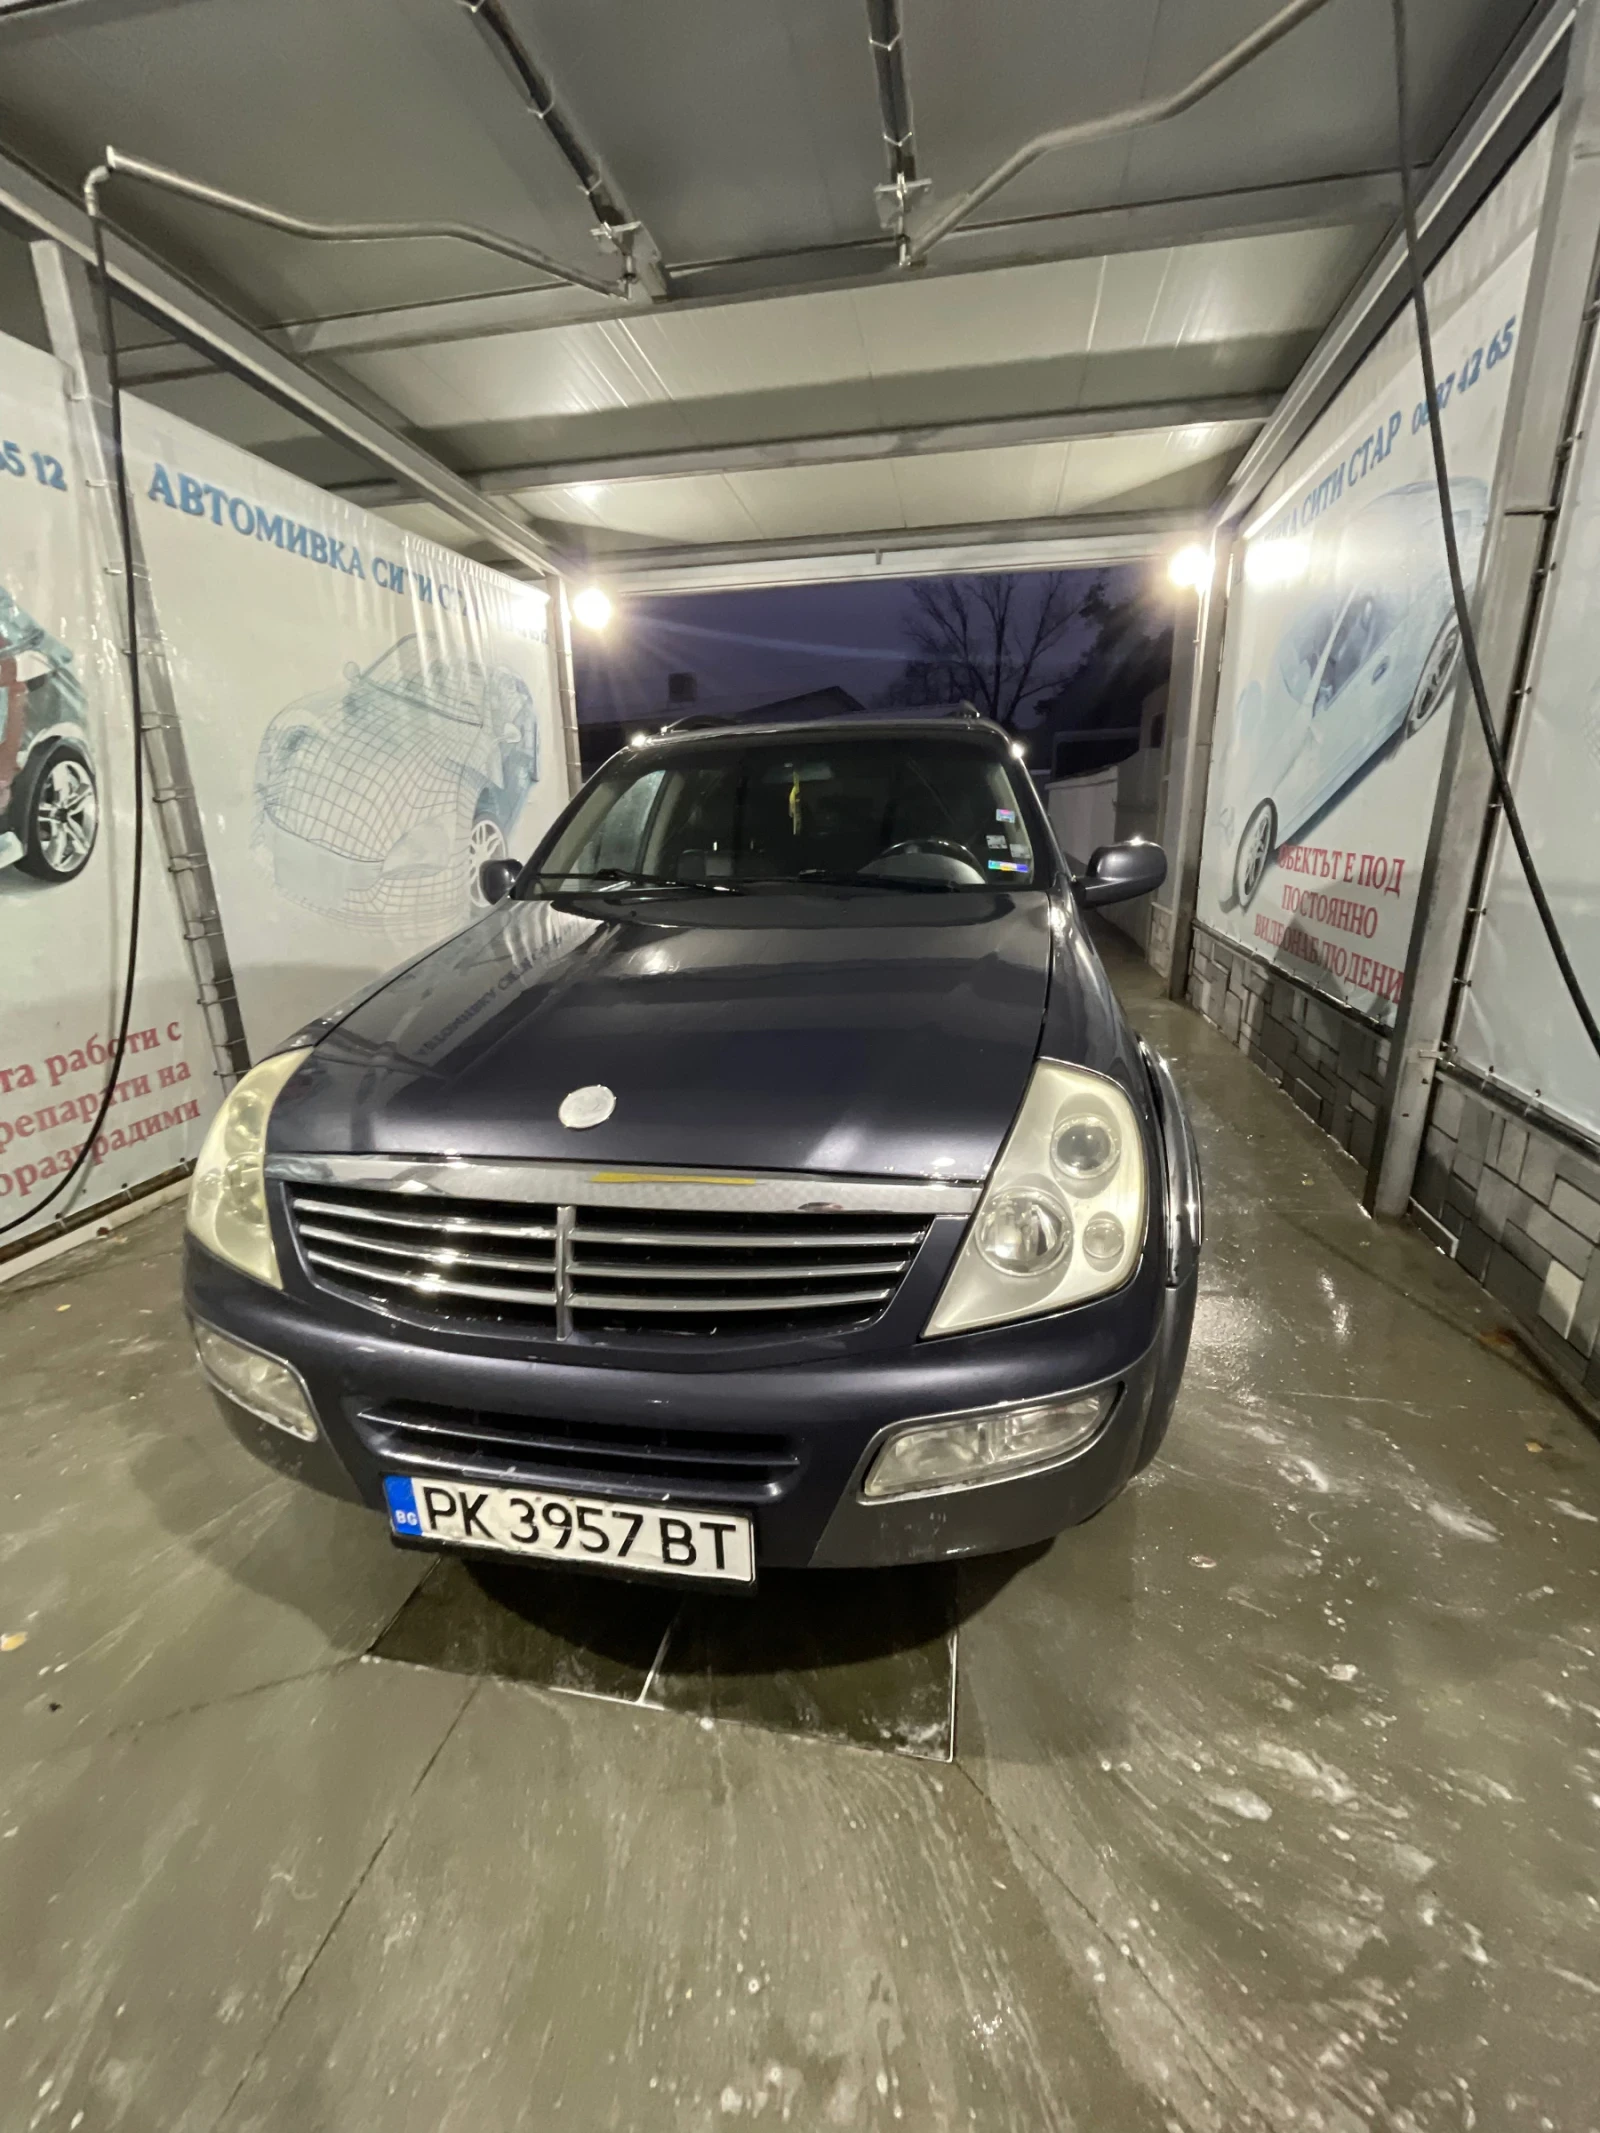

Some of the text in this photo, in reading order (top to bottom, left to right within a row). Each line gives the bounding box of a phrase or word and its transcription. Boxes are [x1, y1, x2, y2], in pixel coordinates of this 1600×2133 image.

[1301, 461, 1346, 528] СИТИ
[1347, 410, 1402, 487] СТАР
[1486, 314, 1516, 370] 65
[0, 440, 67, 491] 5 12
[147, 463, 365, 579] АВТОМИВКА
[1277, 844, 1342, 880] ОБЕКТЪТ
[1357, 854, 1406, 899] ПОД
[1281, 884, 1378, 939] ПОСТОЯННО
[44, 1027, 161, 1086] работи
[157, 1060, 192, 1087] на
[396, 1511, 418, 1526] BG
[423, 1486, 737, 1571] PK 3957 BT
